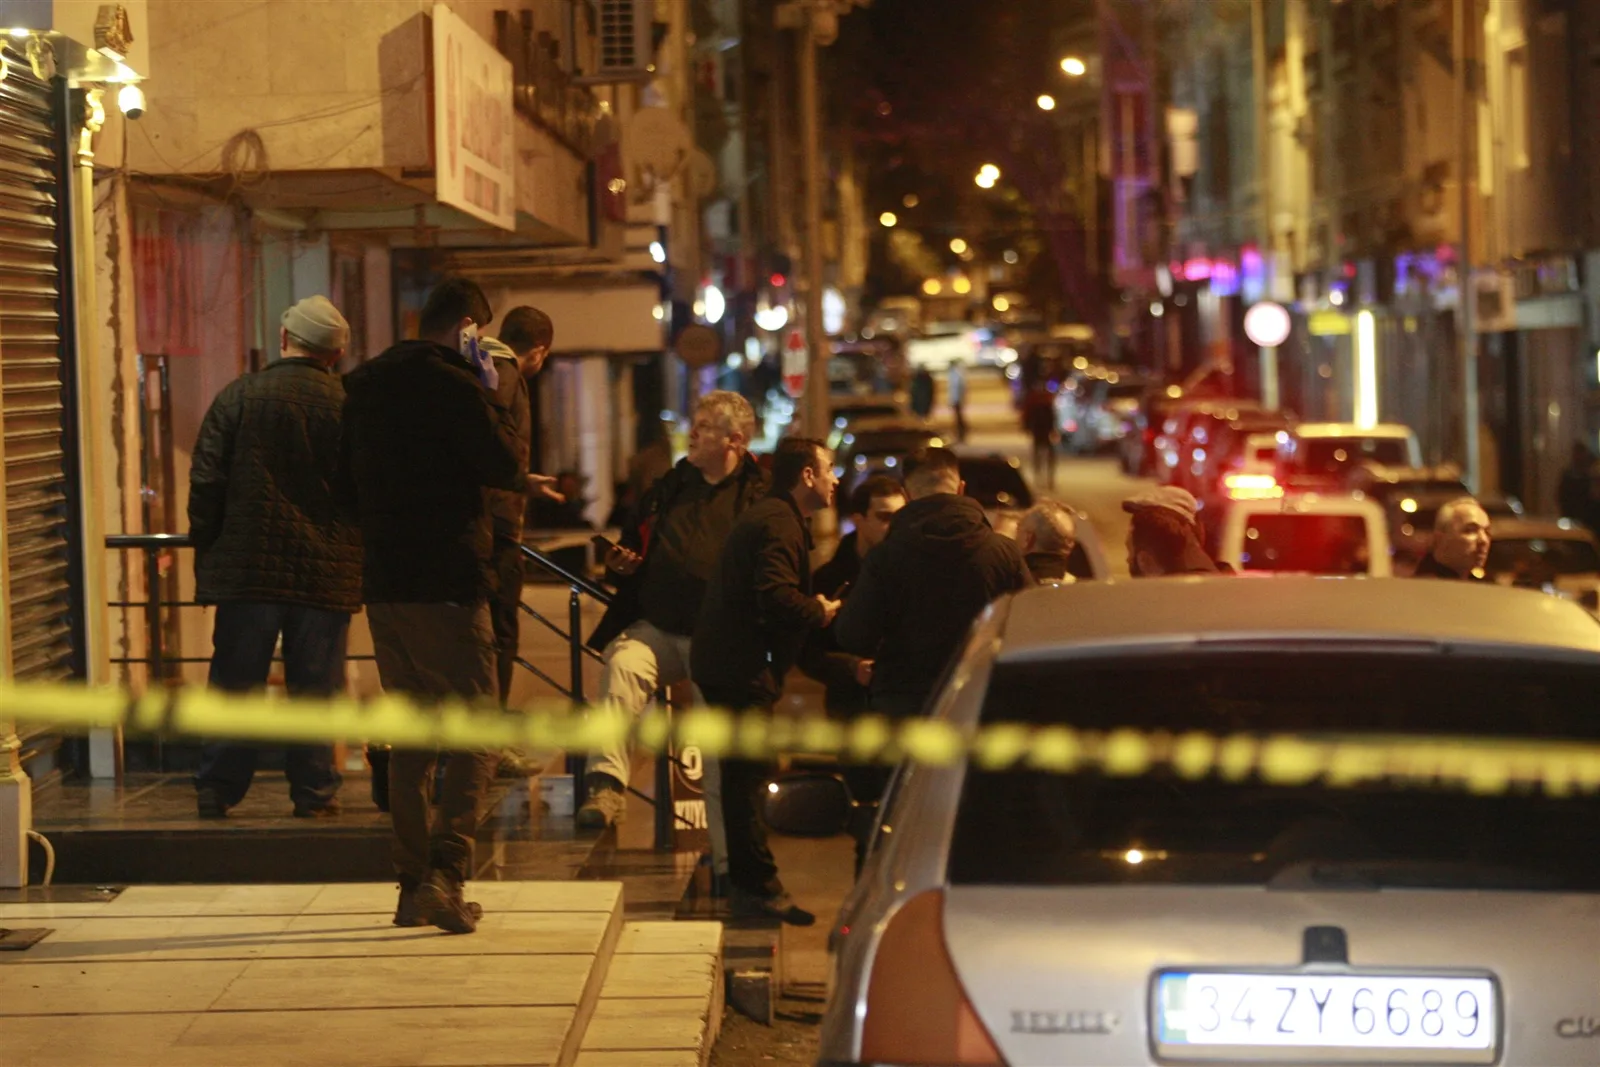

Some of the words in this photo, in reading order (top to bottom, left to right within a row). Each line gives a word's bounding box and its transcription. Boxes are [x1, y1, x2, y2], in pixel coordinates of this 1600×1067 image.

[1199, 984, 1256, 1032] 34
[1275, 986, 1333, 1034] ZY
[1351, 987, 1479, 1037] 6689
